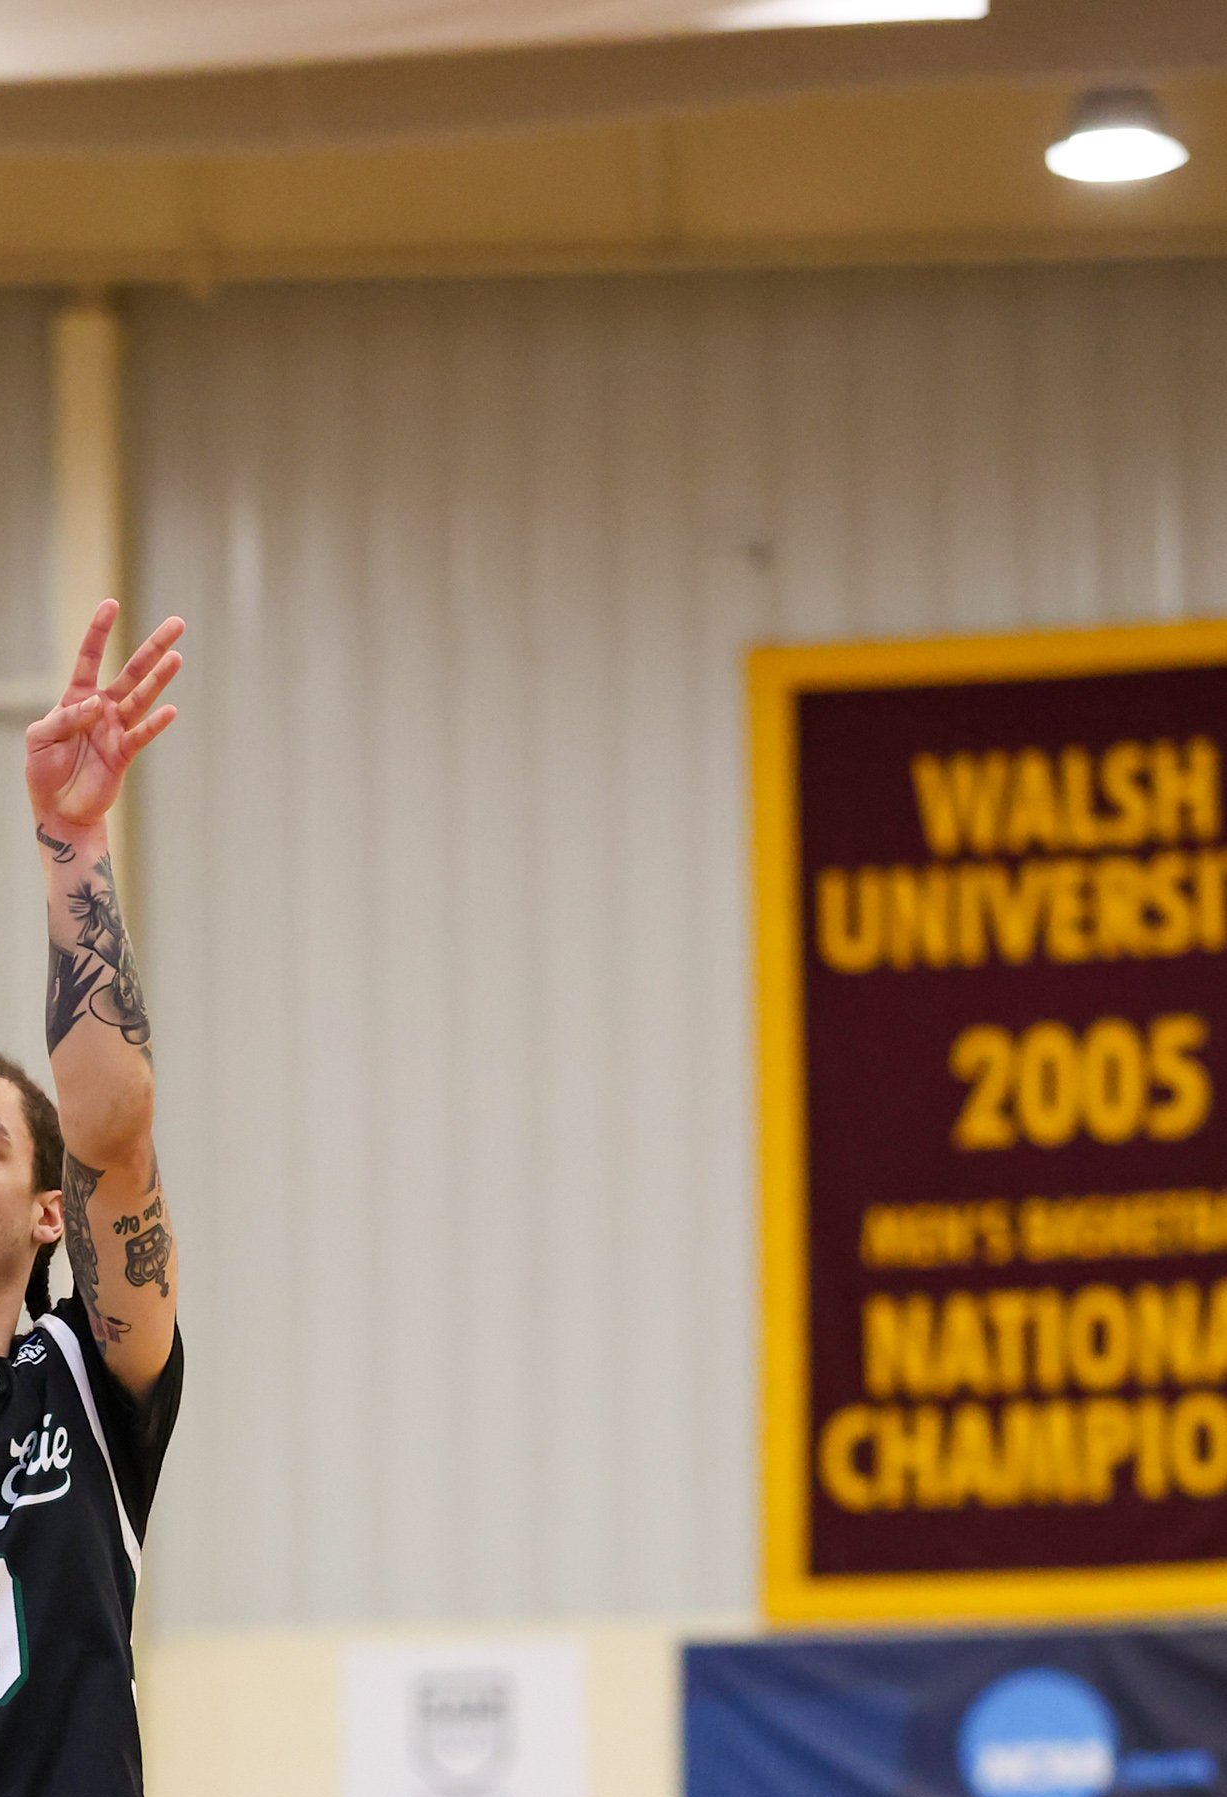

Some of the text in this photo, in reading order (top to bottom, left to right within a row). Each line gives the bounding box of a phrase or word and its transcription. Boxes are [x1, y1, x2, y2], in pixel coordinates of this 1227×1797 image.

[913, 739, 1219, 854] WALSH
[820, 851, 1227, 970] UNIVERSI
[952, 1016, 1209, 1148] 2005
[818, 1391, 1227, 1514] CHAMPIO
